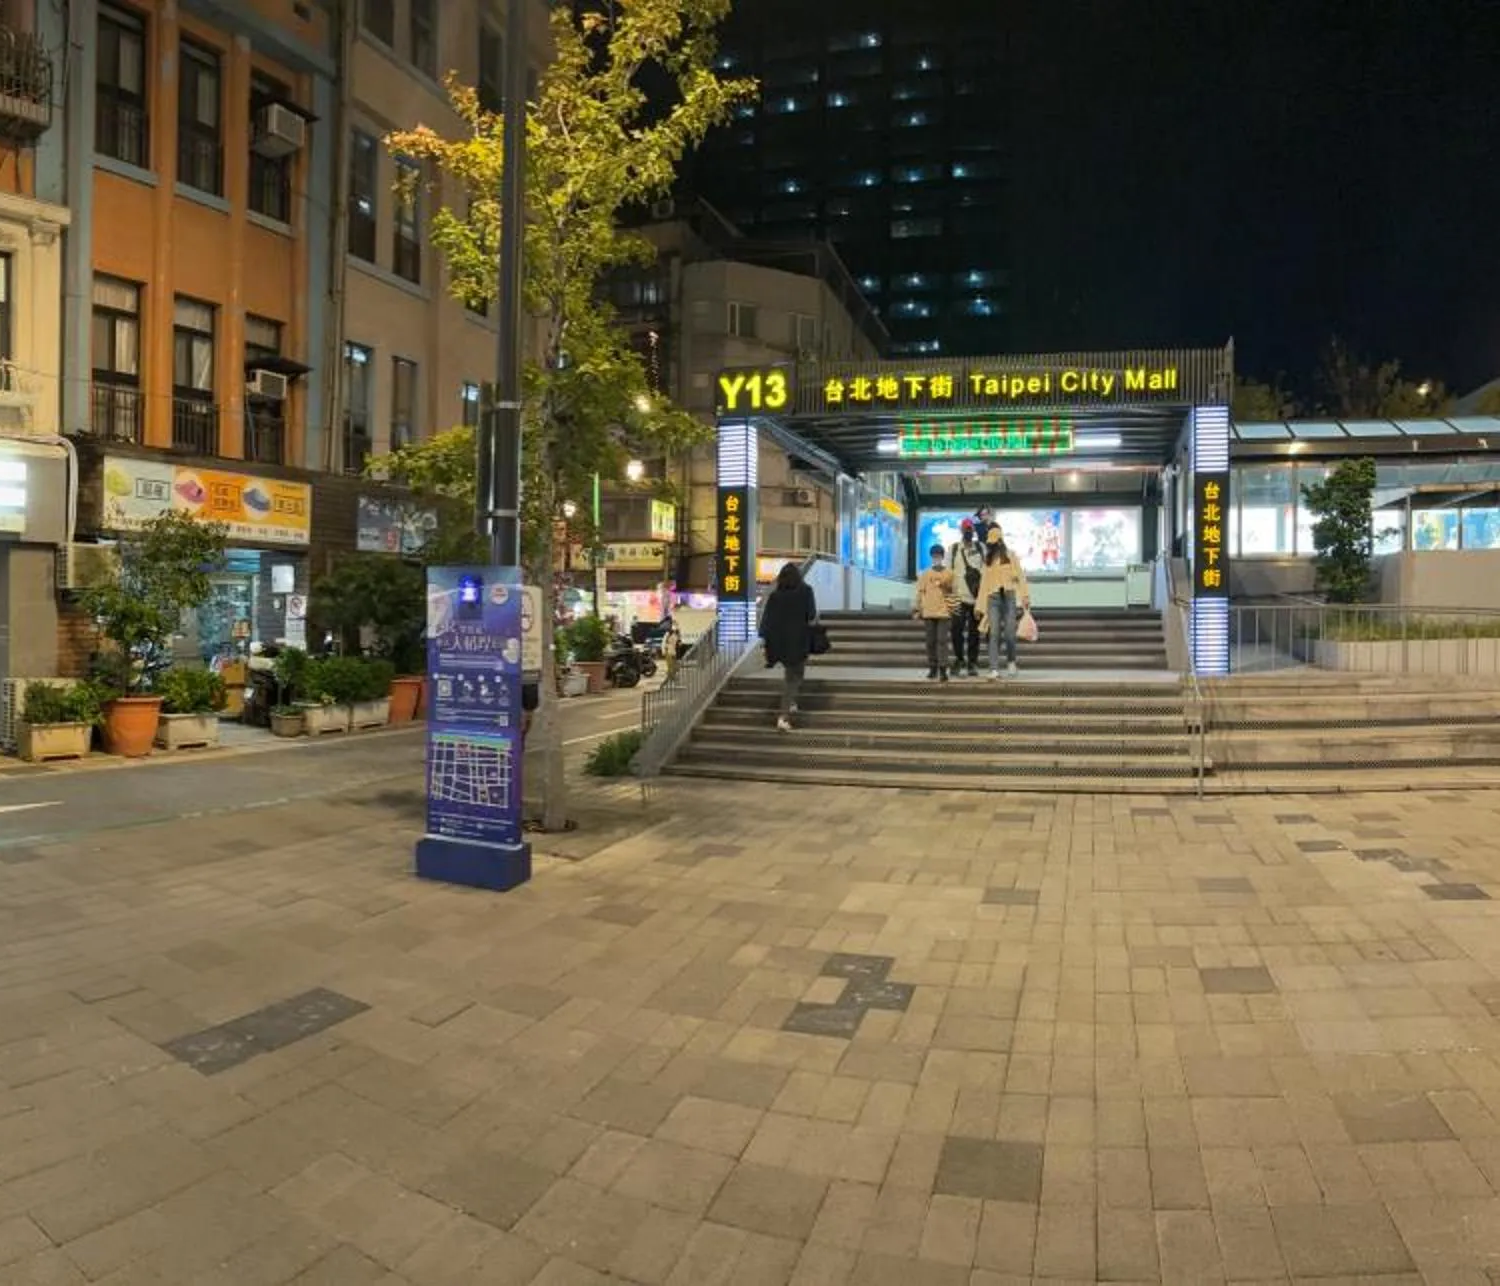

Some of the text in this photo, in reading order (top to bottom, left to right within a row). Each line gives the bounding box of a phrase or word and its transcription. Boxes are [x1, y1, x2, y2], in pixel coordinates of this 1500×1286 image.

[718, 371, 787, 410] Y13
[823, 375, 954, 403] 台北地下街
[970, 369, 1178, 398] Taipei City Mall
[724, 495, 741, 593] 台北地下街
[1203, 481, 1221, 588] 台北地下街
